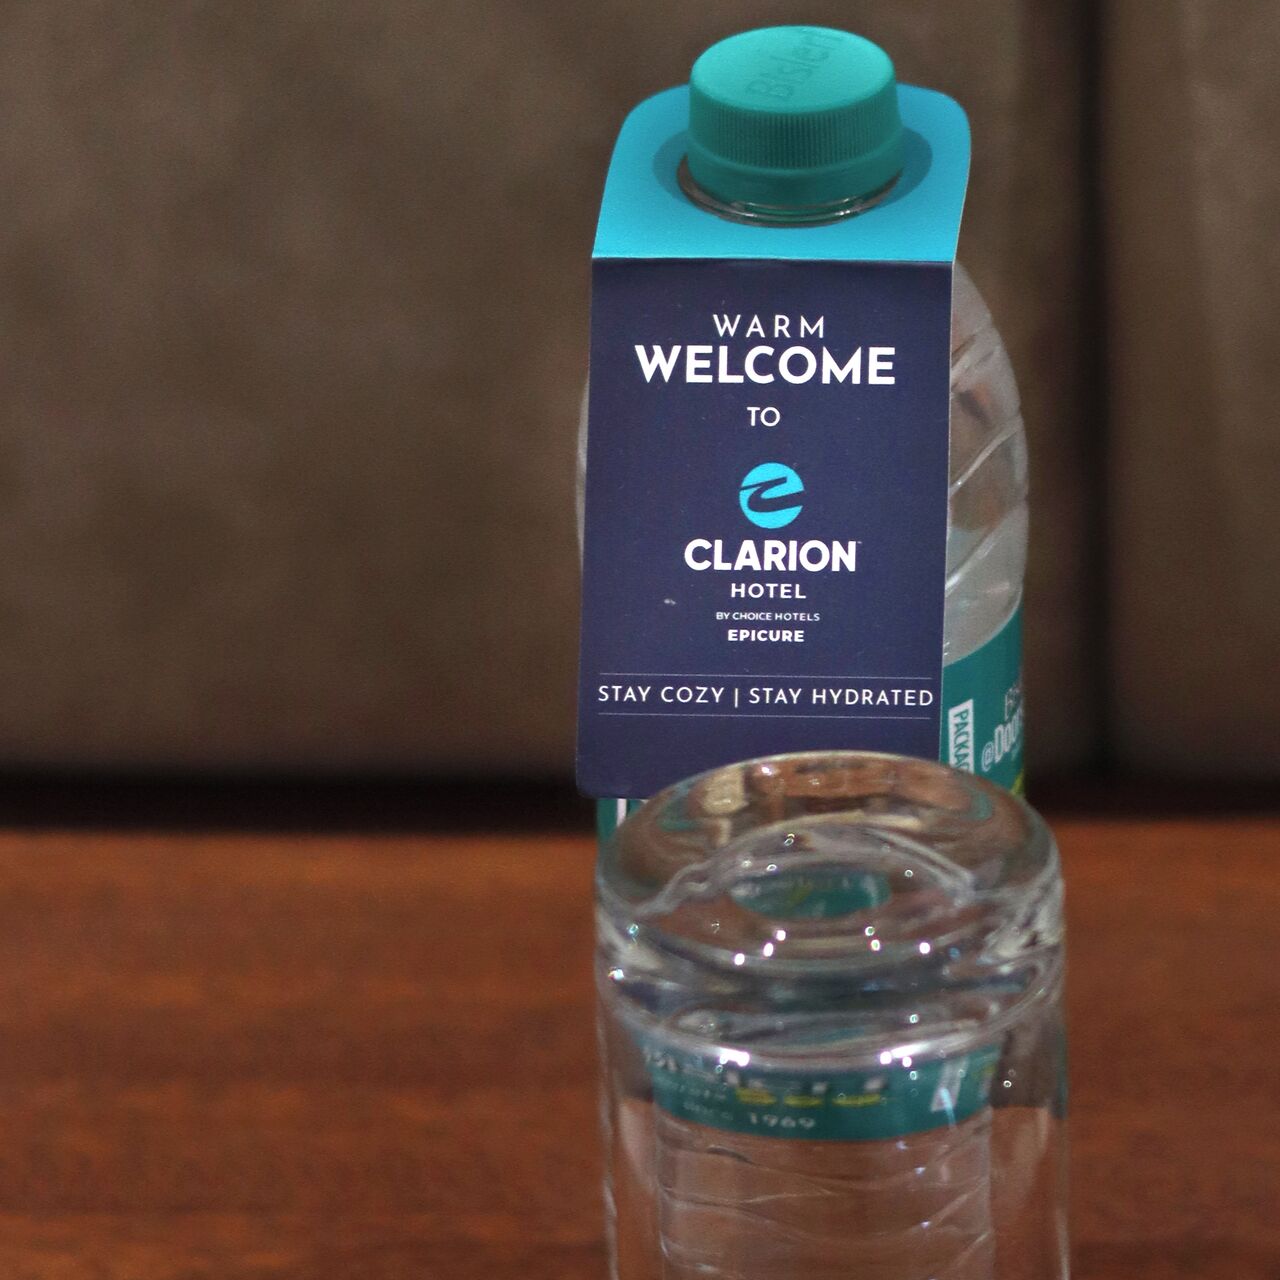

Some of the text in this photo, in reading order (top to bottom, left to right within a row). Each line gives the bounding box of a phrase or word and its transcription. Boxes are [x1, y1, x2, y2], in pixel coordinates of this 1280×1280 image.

[712, 313, 824, 339] WARM
[634, 344, 896, 385] WELCOME
[746, 406, 781, 427] TO
[684, 538, 857, 572] CLARION
[730, 582, 807, 599] HOTEL
[715, 611, 820, 622] BY CHOICE HOTELS
[727, 629, 805, 643] EPICURE
[598, 685, 652, 702] STAY
[660, 686, 725, 703] COZY
[749, 687, 802, 705] STAY
[812, 688, 933, 706] HYDRATED
